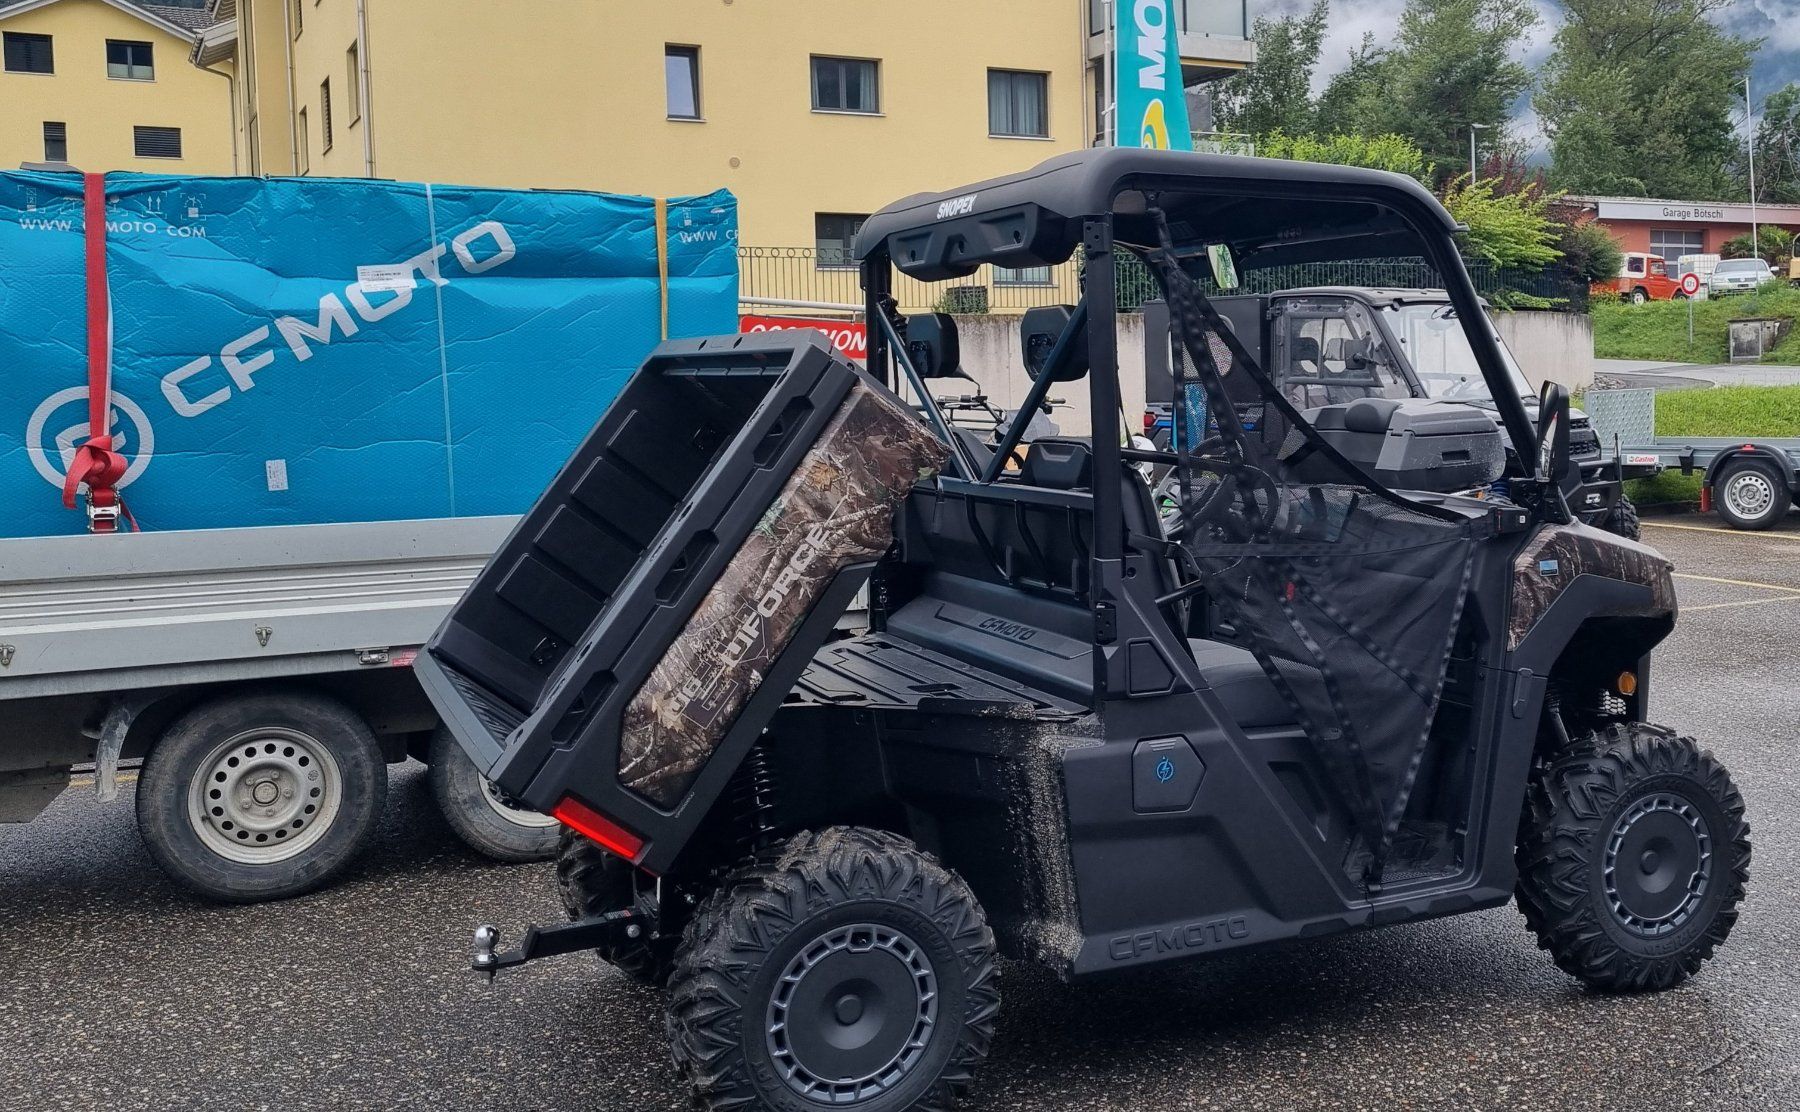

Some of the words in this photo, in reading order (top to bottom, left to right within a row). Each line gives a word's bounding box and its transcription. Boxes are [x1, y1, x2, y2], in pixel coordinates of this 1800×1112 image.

[936, 194, 978, 220] SNOPEX
[1662, 207, 1691, 219] Garage
[1694, 208, 1724, 219] Bötschi
[160, 221, 516, 418] CFMOTO
[719, 525, 831, 668] UFORCE
[978, 617, 1037, 641] CFMOTO
[1109, 914, 1250, 961] CFMOTO
